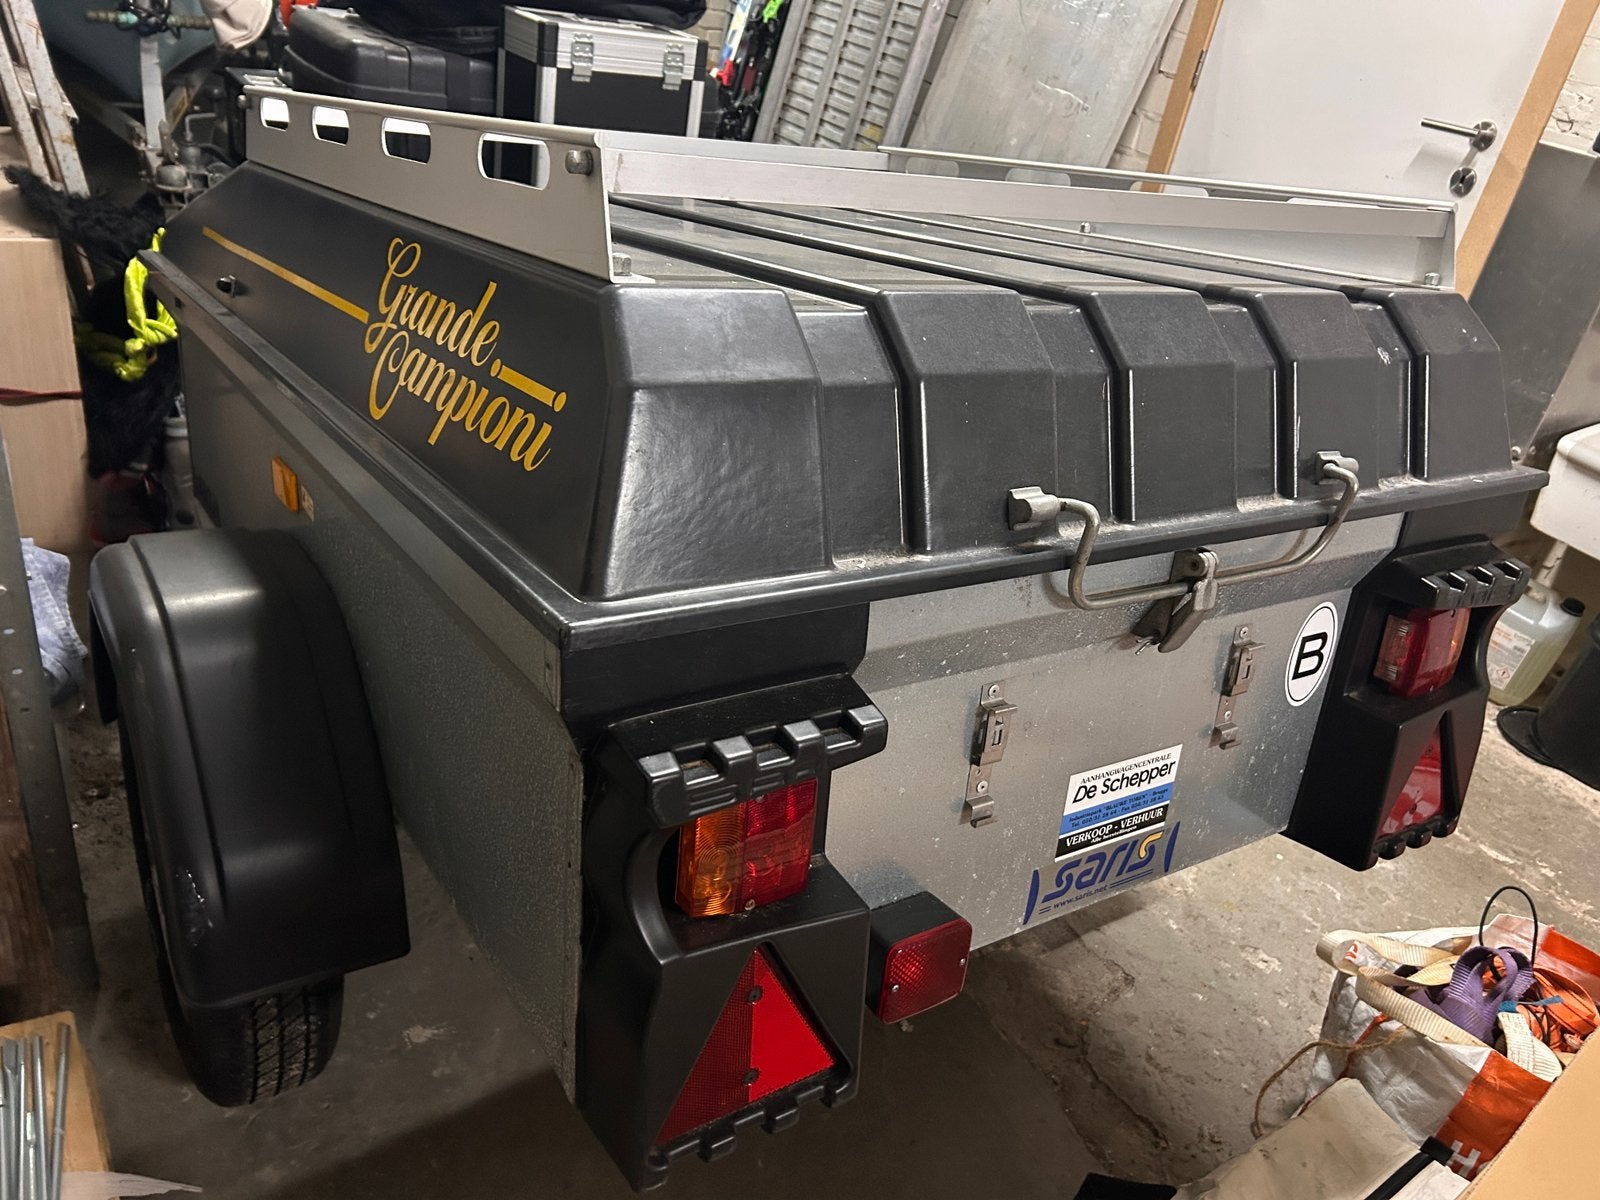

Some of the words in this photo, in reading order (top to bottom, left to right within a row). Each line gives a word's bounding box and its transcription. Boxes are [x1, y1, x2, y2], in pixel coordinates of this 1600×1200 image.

[364, 237, 500, 367] Grande
[368, 330, 553, 472] Campioni
[1292, 631, 1328, 681] B
[1072, 785, 1098, 803] De
[1101, 761, 1176, 795] Schepper
[1080, 753, 1172, 785] AANHANGWAGENCENTRALE
[1066, 824, 1113, 847] VERKOOP
[1120, 807, 1164, 829] VERHUUR
[1090, 836, 1102, 844] Alle
[1103, 825, 1138, 840] herstellingen
[1041, 831, 1163, 904] saris
[1053, 884, 1108, 909] www.saris.net
